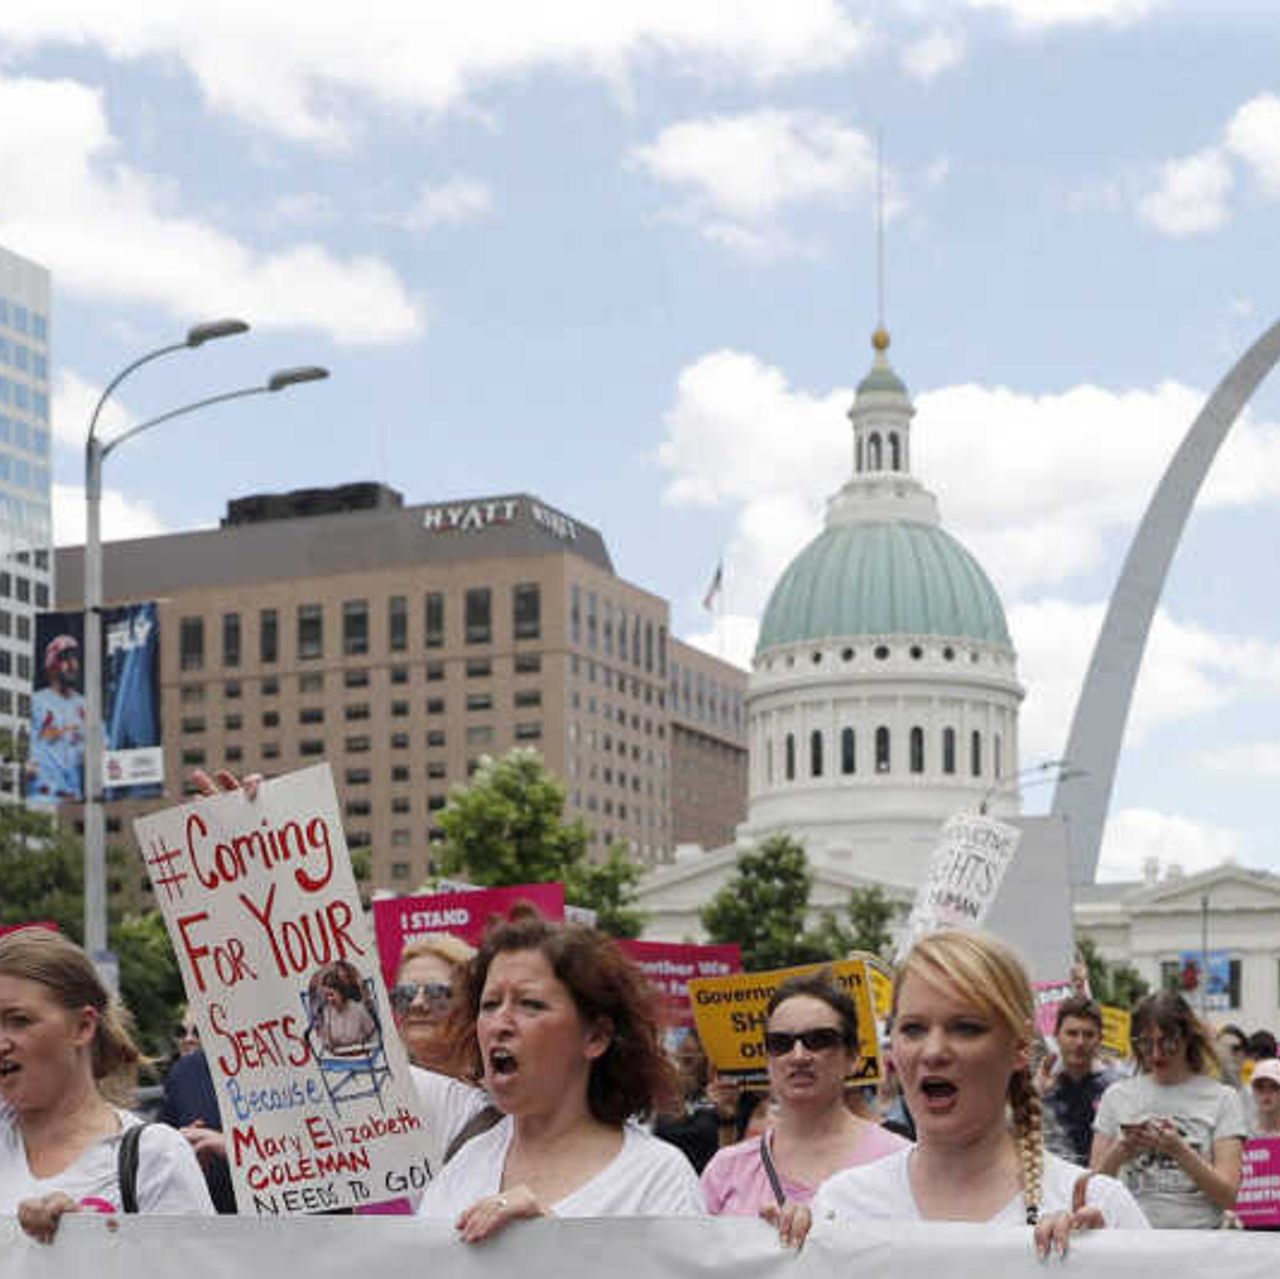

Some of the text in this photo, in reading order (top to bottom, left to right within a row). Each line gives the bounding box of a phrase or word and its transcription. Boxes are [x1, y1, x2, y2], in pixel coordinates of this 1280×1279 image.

[423, 500, 517, 529] HYATT
[238, 882, 366, 979] YOUR
[400, 908, 470, 931] I STAND
[231, 1105, 421, 1168] Mary Elizabeth
[246, 1146, 372, 1191] COLEMAN
[252, 1182, 341, 1216] NEEDS
